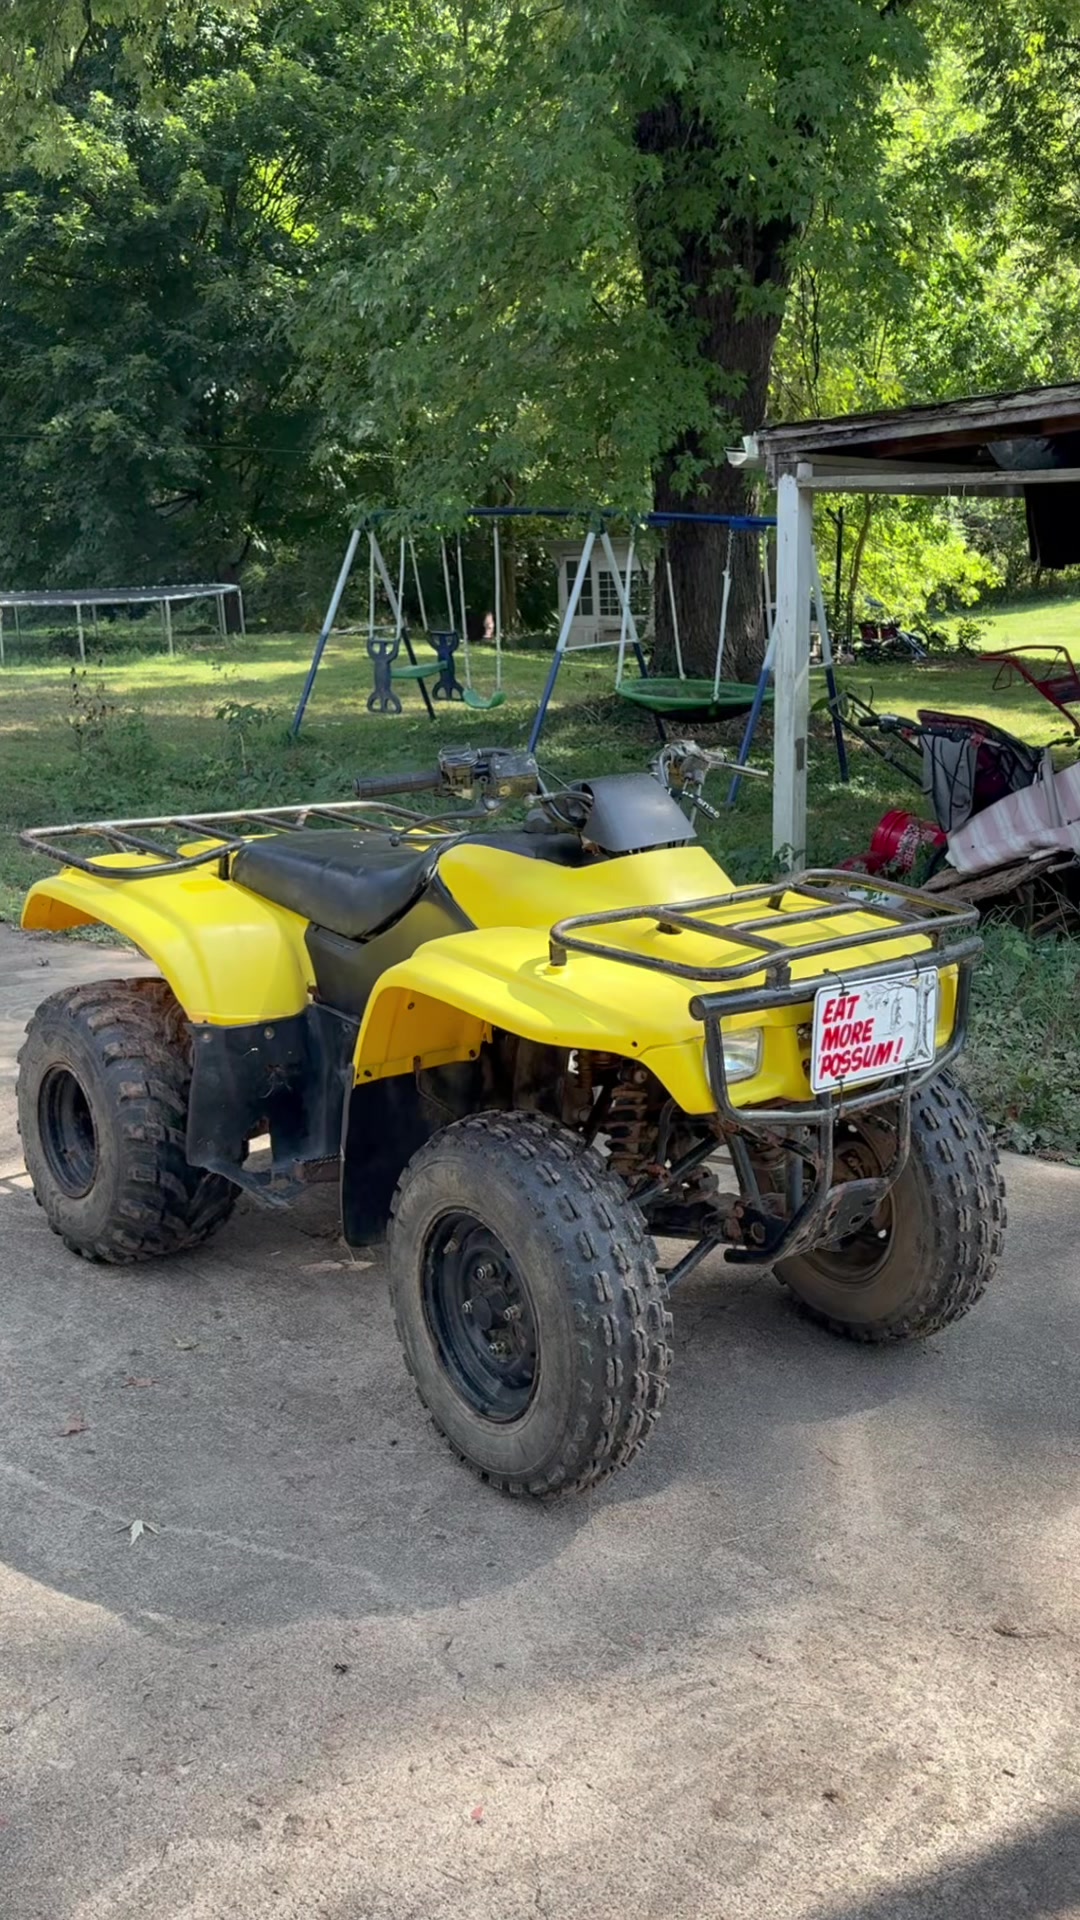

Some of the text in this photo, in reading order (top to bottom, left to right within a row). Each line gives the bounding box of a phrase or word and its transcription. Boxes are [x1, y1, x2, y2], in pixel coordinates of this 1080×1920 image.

[822, 995, 861, 1025] EAT
[820, 1018, 875, 1051] MORE
[819, 1037, 904, 1079] POSSUM!
